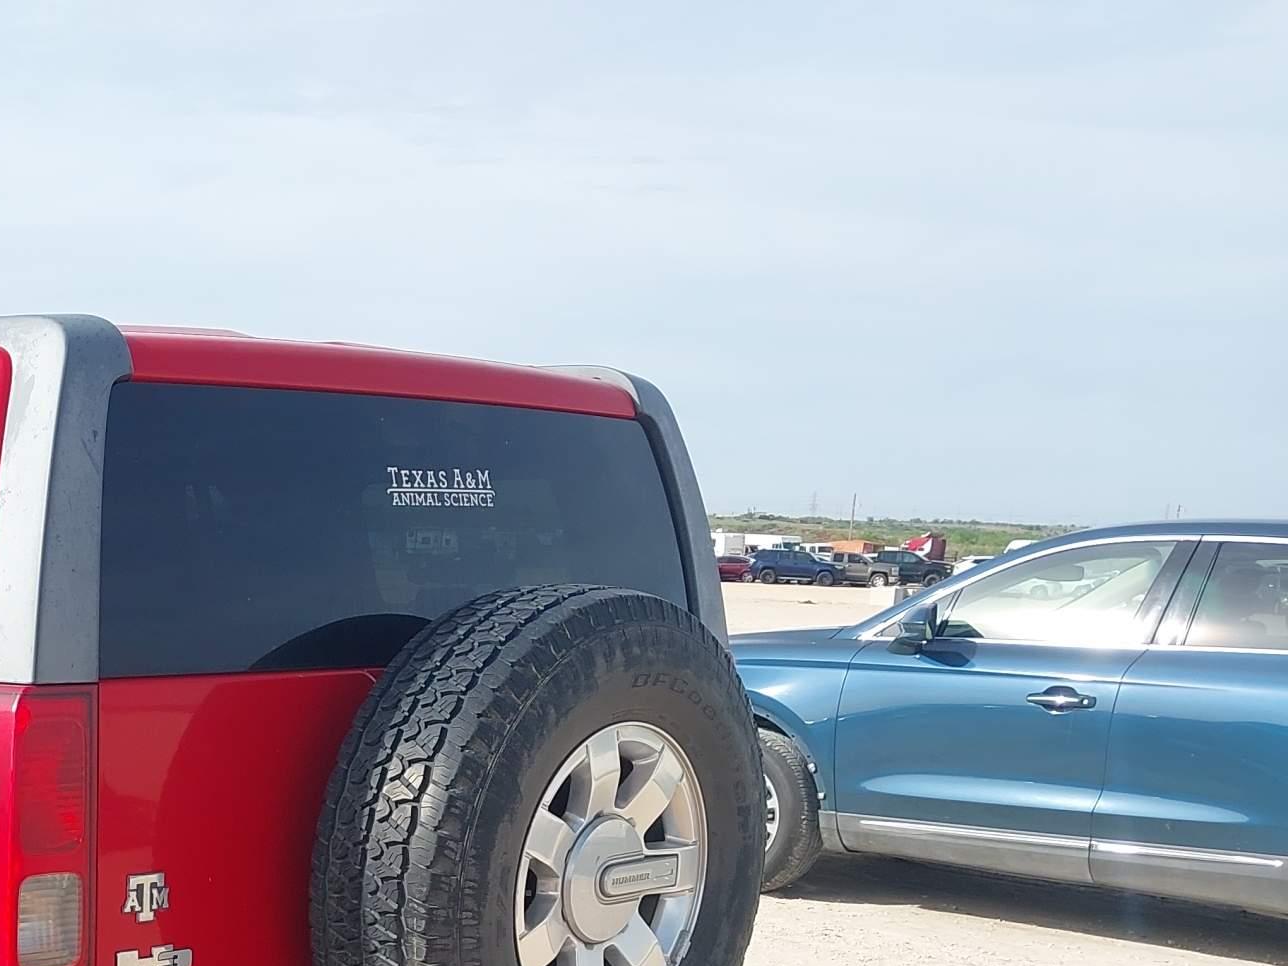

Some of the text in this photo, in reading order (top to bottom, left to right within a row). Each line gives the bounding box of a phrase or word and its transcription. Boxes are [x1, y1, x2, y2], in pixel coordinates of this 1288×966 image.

[387, 467, 492, 489] TEXAS A&M
[392, 493, 494, 507] ANIMAL SCIENCE
